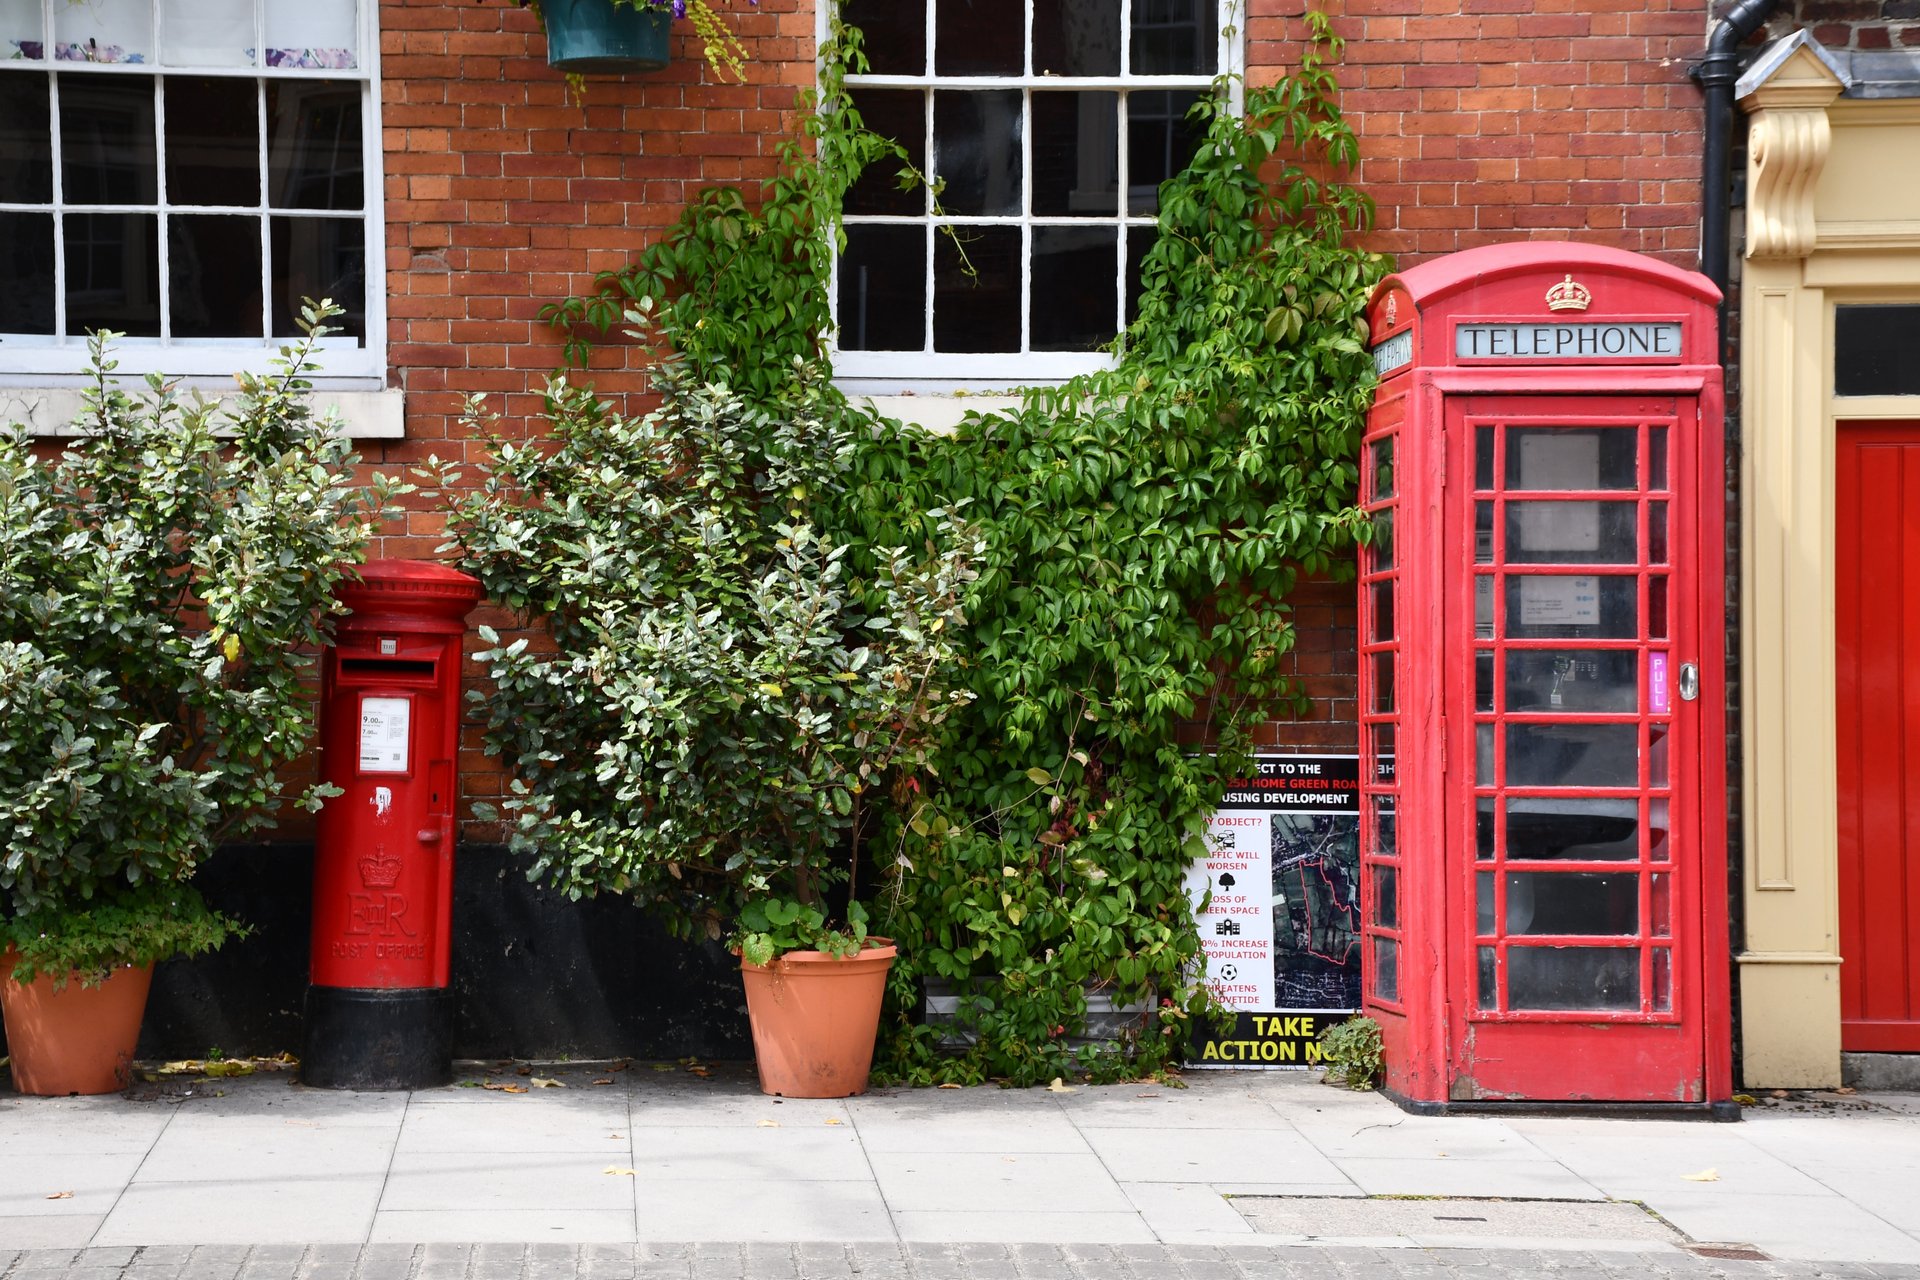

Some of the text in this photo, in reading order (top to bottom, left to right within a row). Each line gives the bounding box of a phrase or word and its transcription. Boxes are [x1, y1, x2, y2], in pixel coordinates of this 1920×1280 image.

[1464, 327, 1671, 355] TELEPHONE
[1653, 658, 1664, 707] PULL
[1278, 764, 1295, 774] TO
[1298, 764, 1321, 775] THE
[1251, 778, 1286, 789] HOME
[1289, 779, 1329, 789] GREEN
[1332, 779, 1358, 789] ROA
[1222, 792, 1350, 804] USING DEVELOPMENT
[1217, 817, 1262, 826] OBJECT?
[1235, 851, 1260, 859] WILL
[1206, 862, 1248, 870] WORSEN
[1234, 895, 1247, 903] OF
[1230, 906, 1260, 914] SPACE
[1221, 940, 1269, 948] INCREASE
[331, 942, 425, 960] POST OFFICE
[1205, 951, 1267, 959] POPULATION
[1207, 996, 1260, 1004] HROVETIDE
[1252, 1016, 1314, 1037] TAKE
[1202, 1040, 1296, 1061] ACTION
